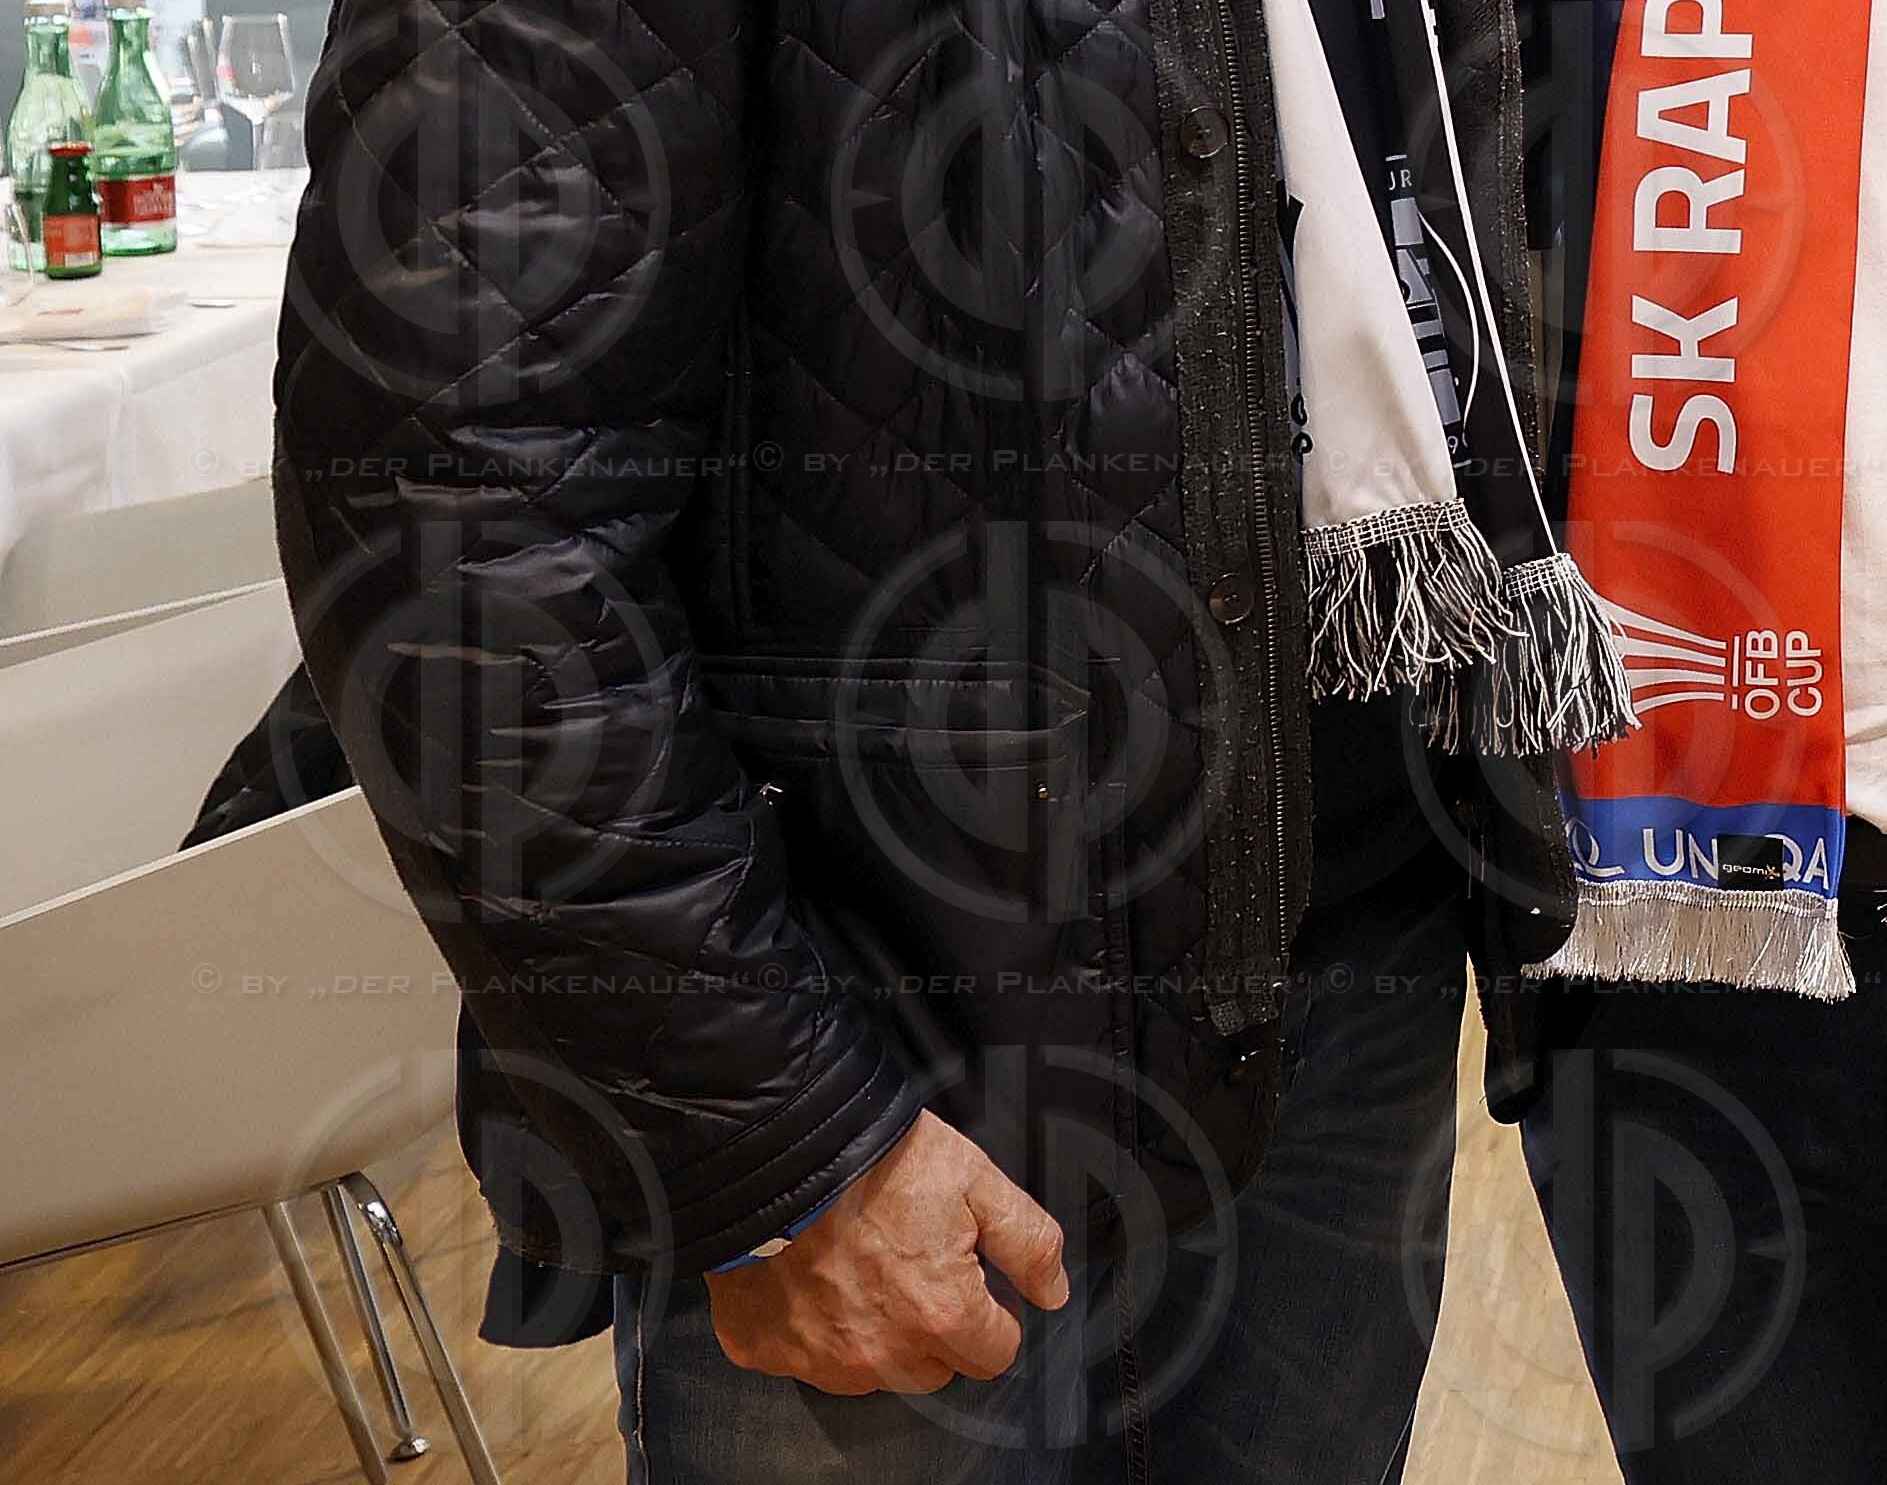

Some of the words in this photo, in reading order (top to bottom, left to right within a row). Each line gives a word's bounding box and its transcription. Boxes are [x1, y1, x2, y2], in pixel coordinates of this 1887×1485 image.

[1628, 296, 1740, 477] SK
[1731, 628, 1780, 721] ÖFB
[1783, 629, 1824, 717] CUP
[1641, 827, 1830, 891] UNQA
